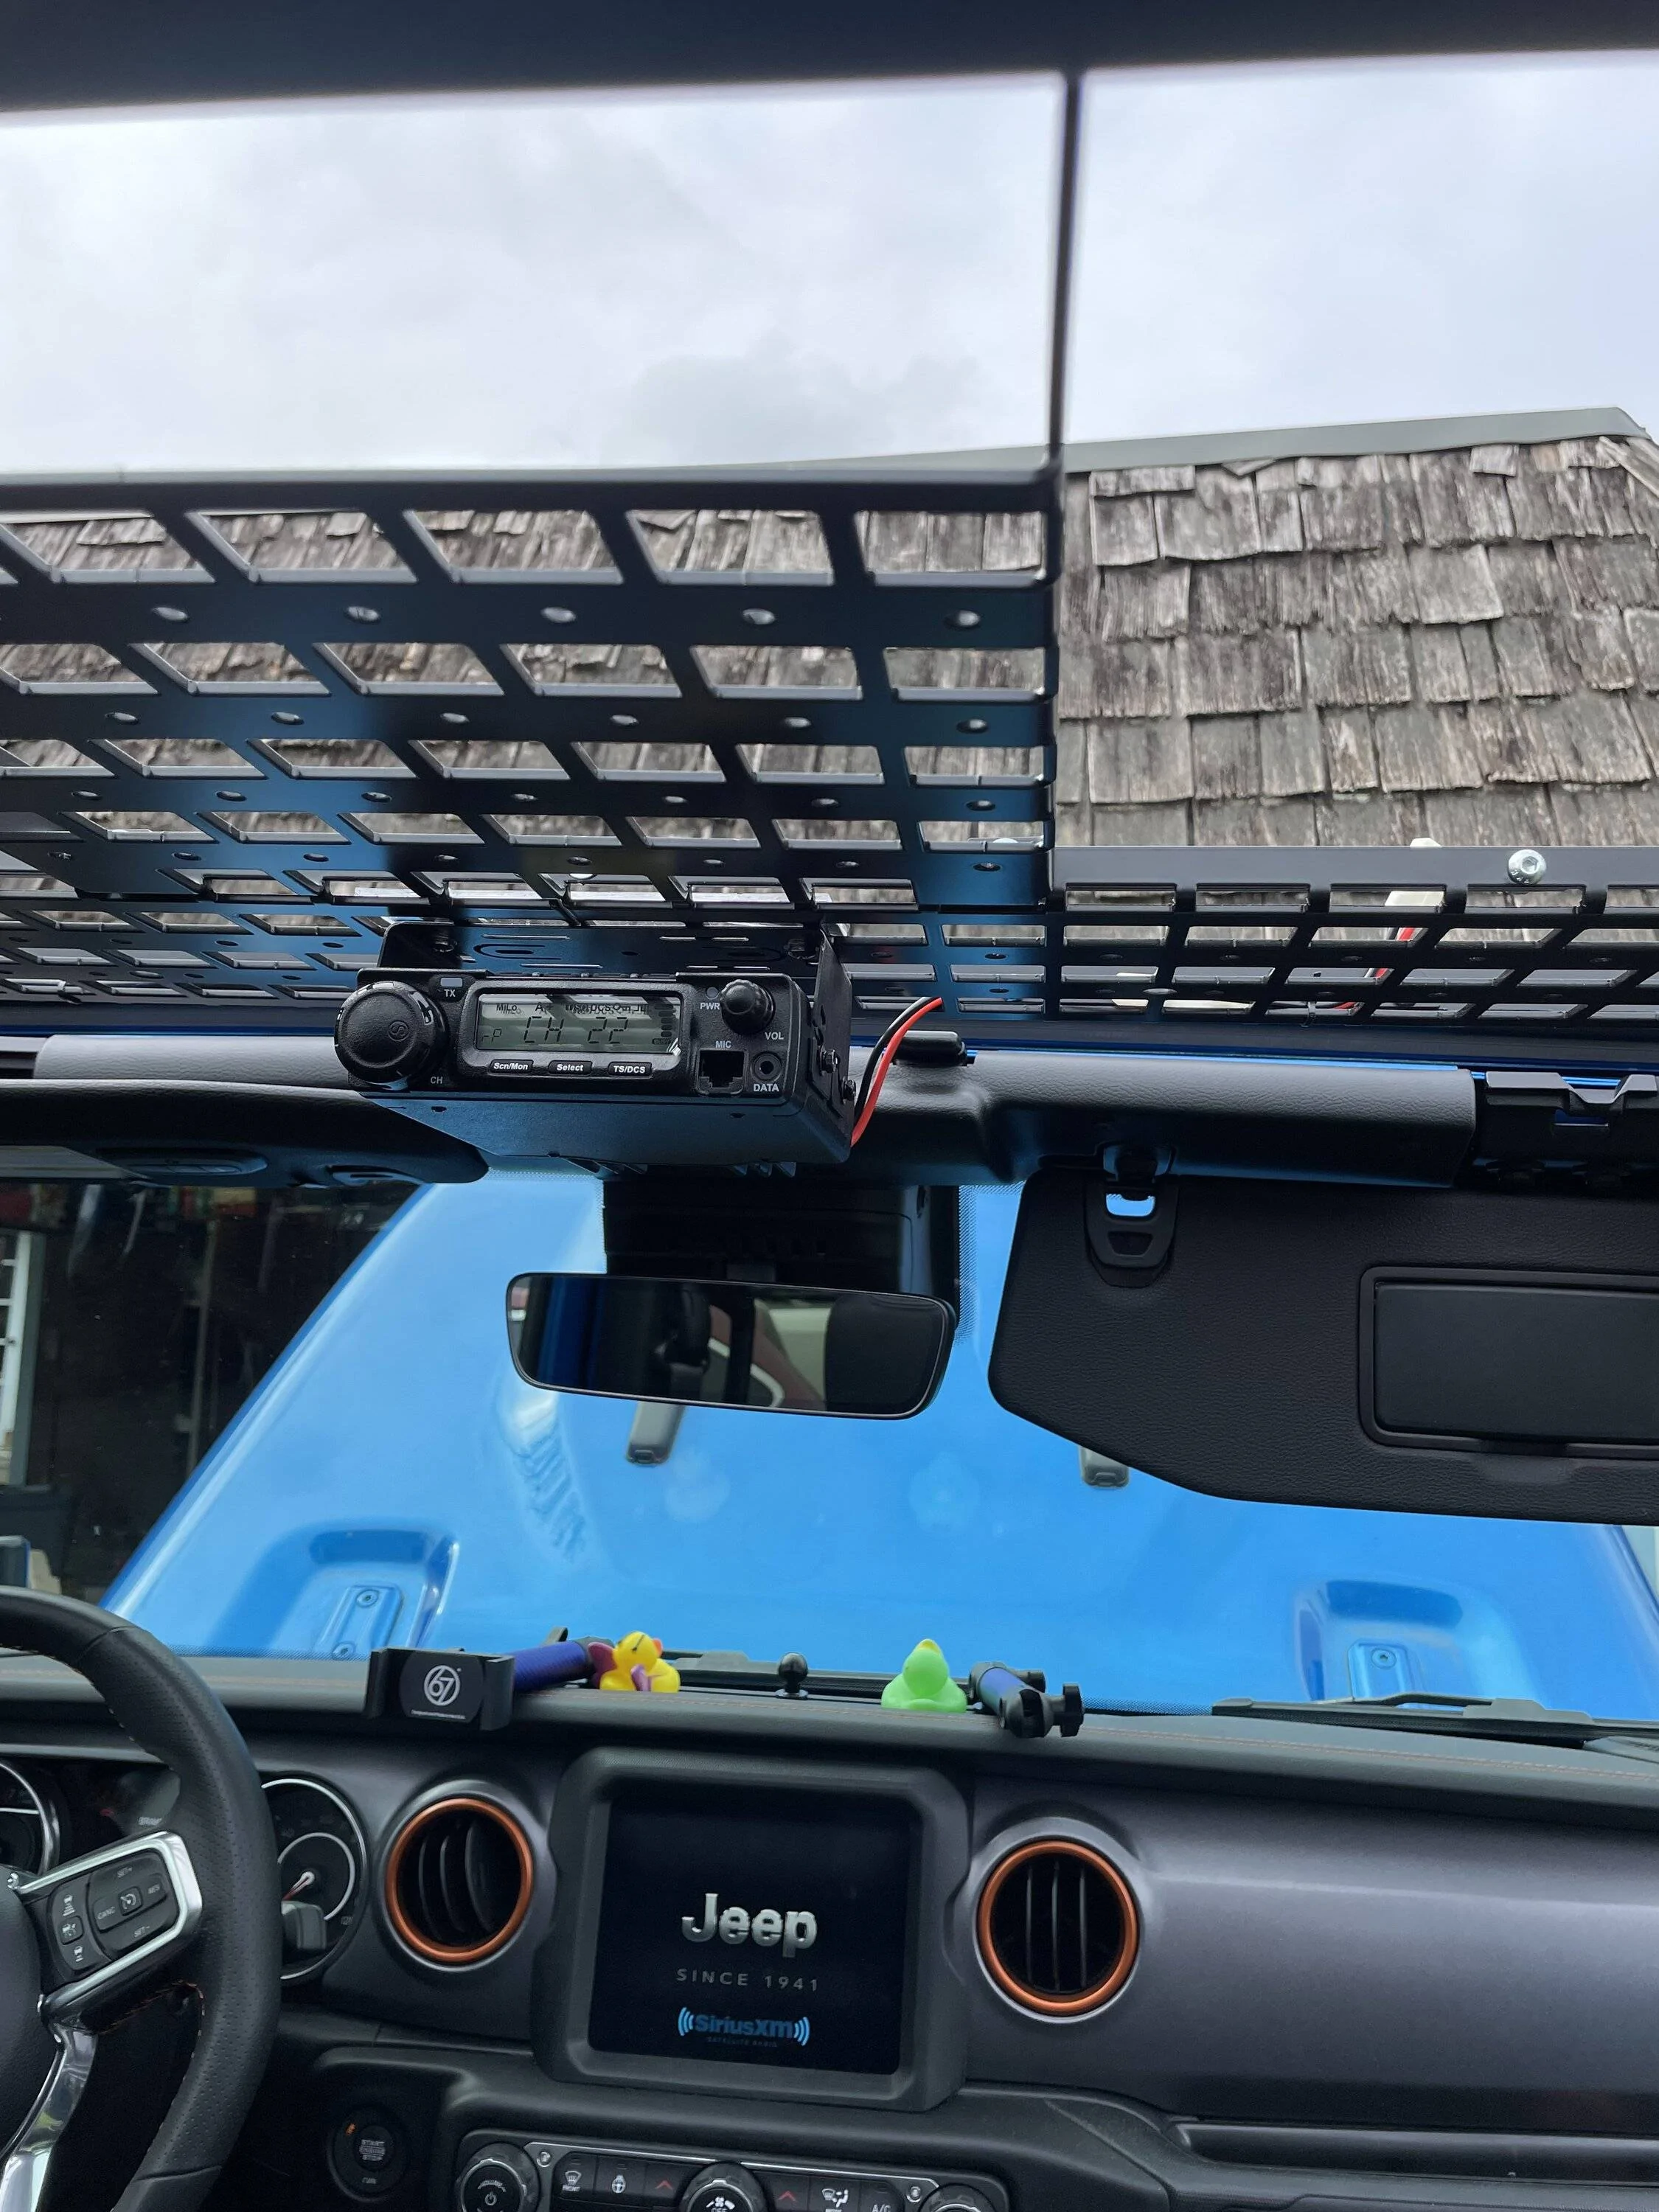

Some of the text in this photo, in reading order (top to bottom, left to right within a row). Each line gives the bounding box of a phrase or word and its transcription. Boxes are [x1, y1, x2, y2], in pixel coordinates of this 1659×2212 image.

[444, 989, 456, 998] TX
[700, 1002, 720, 1010] PWR
[523, 1016, 564, 1043] CH
[588, 1017, 628, 1044] 22
[765, 1032, 784, 1040] VOL
[715, 1040, 732, 1048] MIC
[493, 1062, 529, 1071] Scn/Mon
[556, 1063, 584, 1071] Select
[613, 1065, 646, 1074] TS/DCS
[430, 1076, 443, 1085] CH
[753, 1083, 779, 1092] DATA
[681, 1893, 818, 1958] Jeep
[676, 1968, 817, 1992] SINCE 1941
